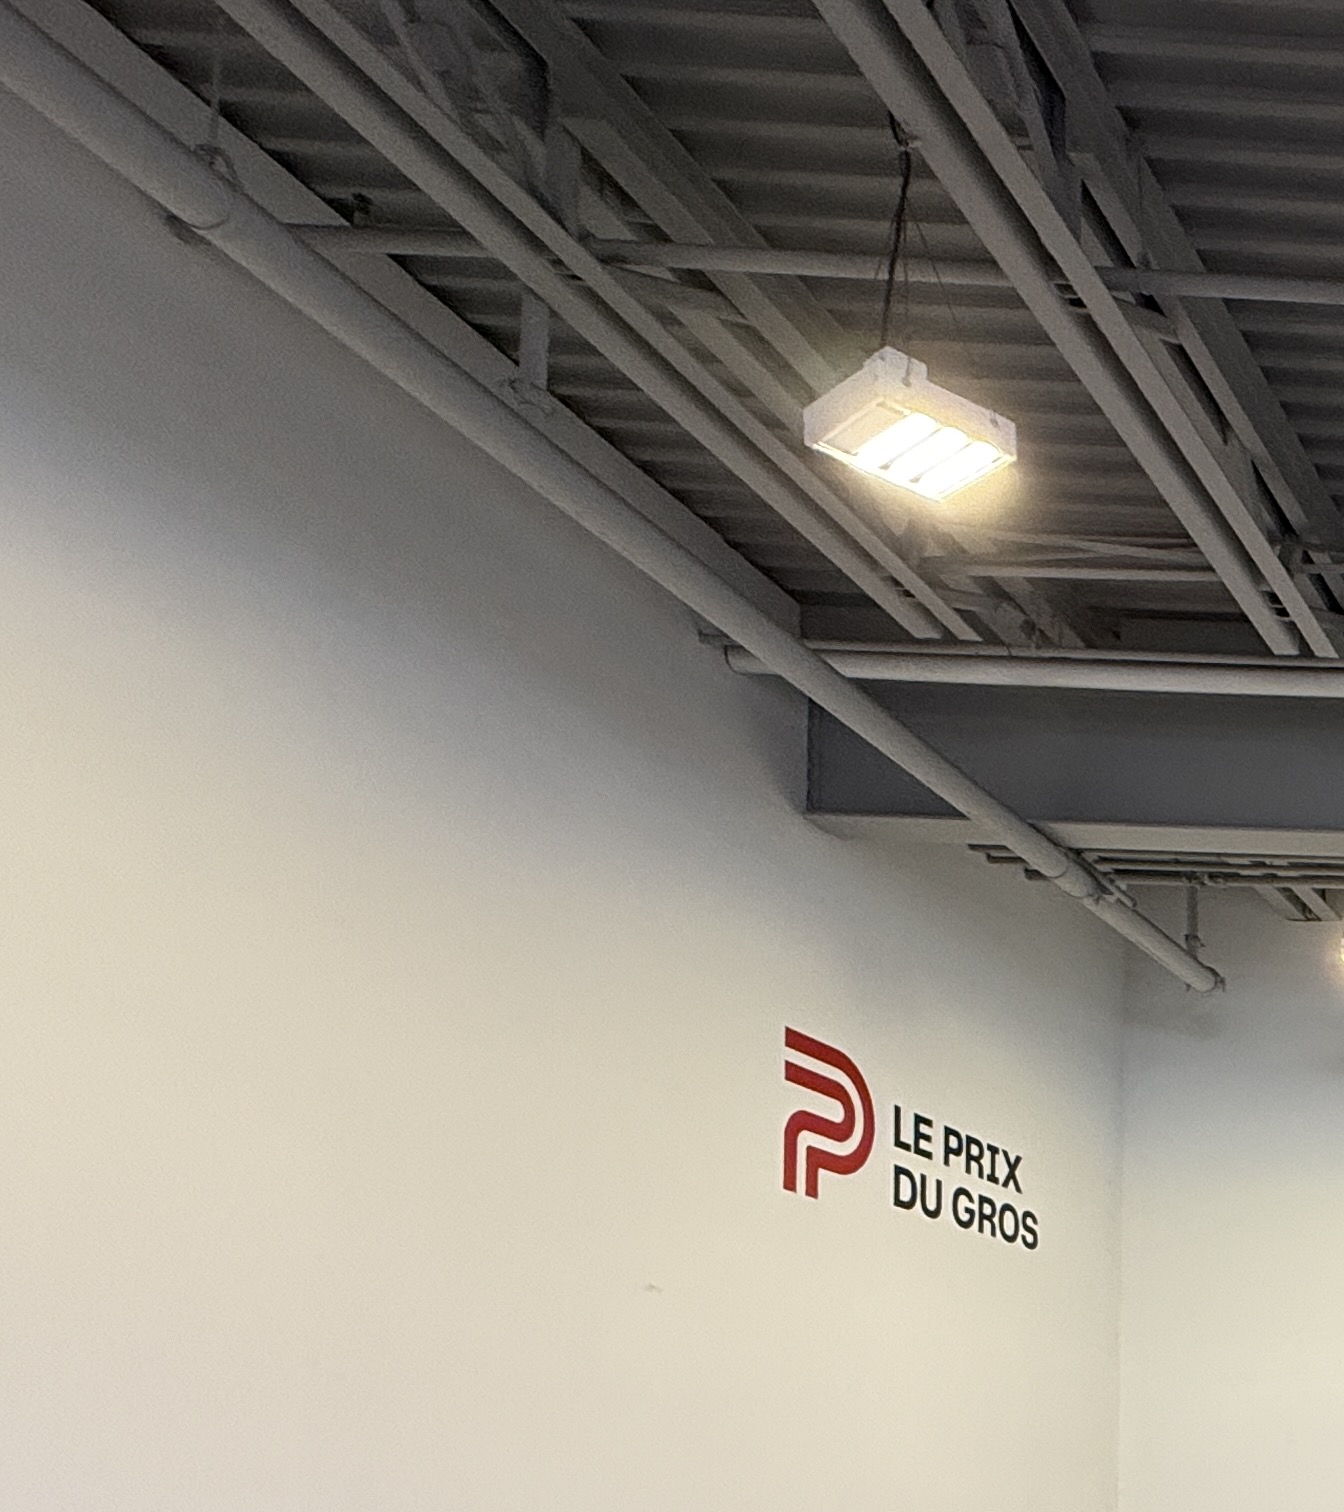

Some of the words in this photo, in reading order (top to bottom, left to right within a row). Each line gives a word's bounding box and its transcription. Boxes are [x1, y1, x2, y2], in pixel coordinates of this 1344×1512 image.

[894, 1104, 933, 1159] LE
[943, 1125, 1022, 1193] PRIX
[894, 1164, 942, 1219] DU
[953, 1187, 1038, 1250] GROS
